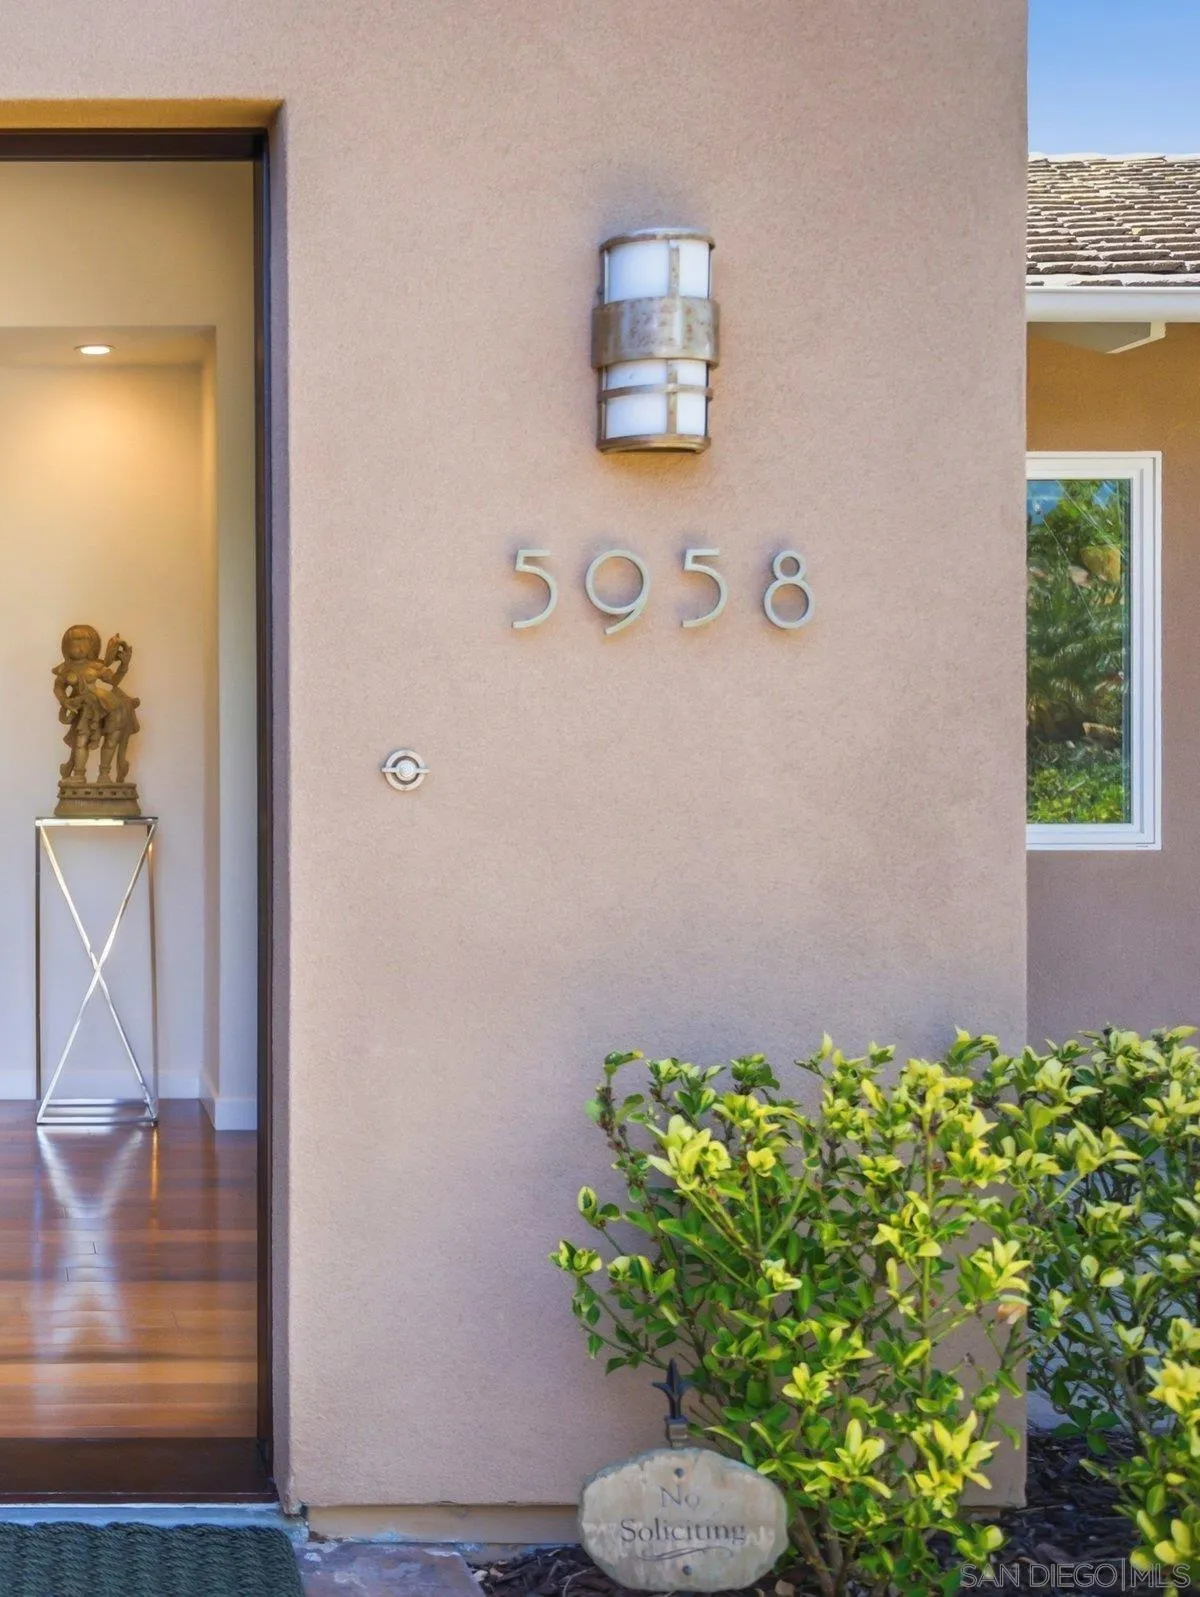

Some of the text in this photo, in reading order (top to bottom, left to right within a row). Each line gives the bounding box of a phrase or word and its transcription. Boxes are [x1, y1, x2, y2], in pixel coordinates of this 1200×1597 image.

[511, 548, 815, 635] 5958
[660, 1484, 701, 1509] No
[620, 1517, 746, 1544] Soliciting
